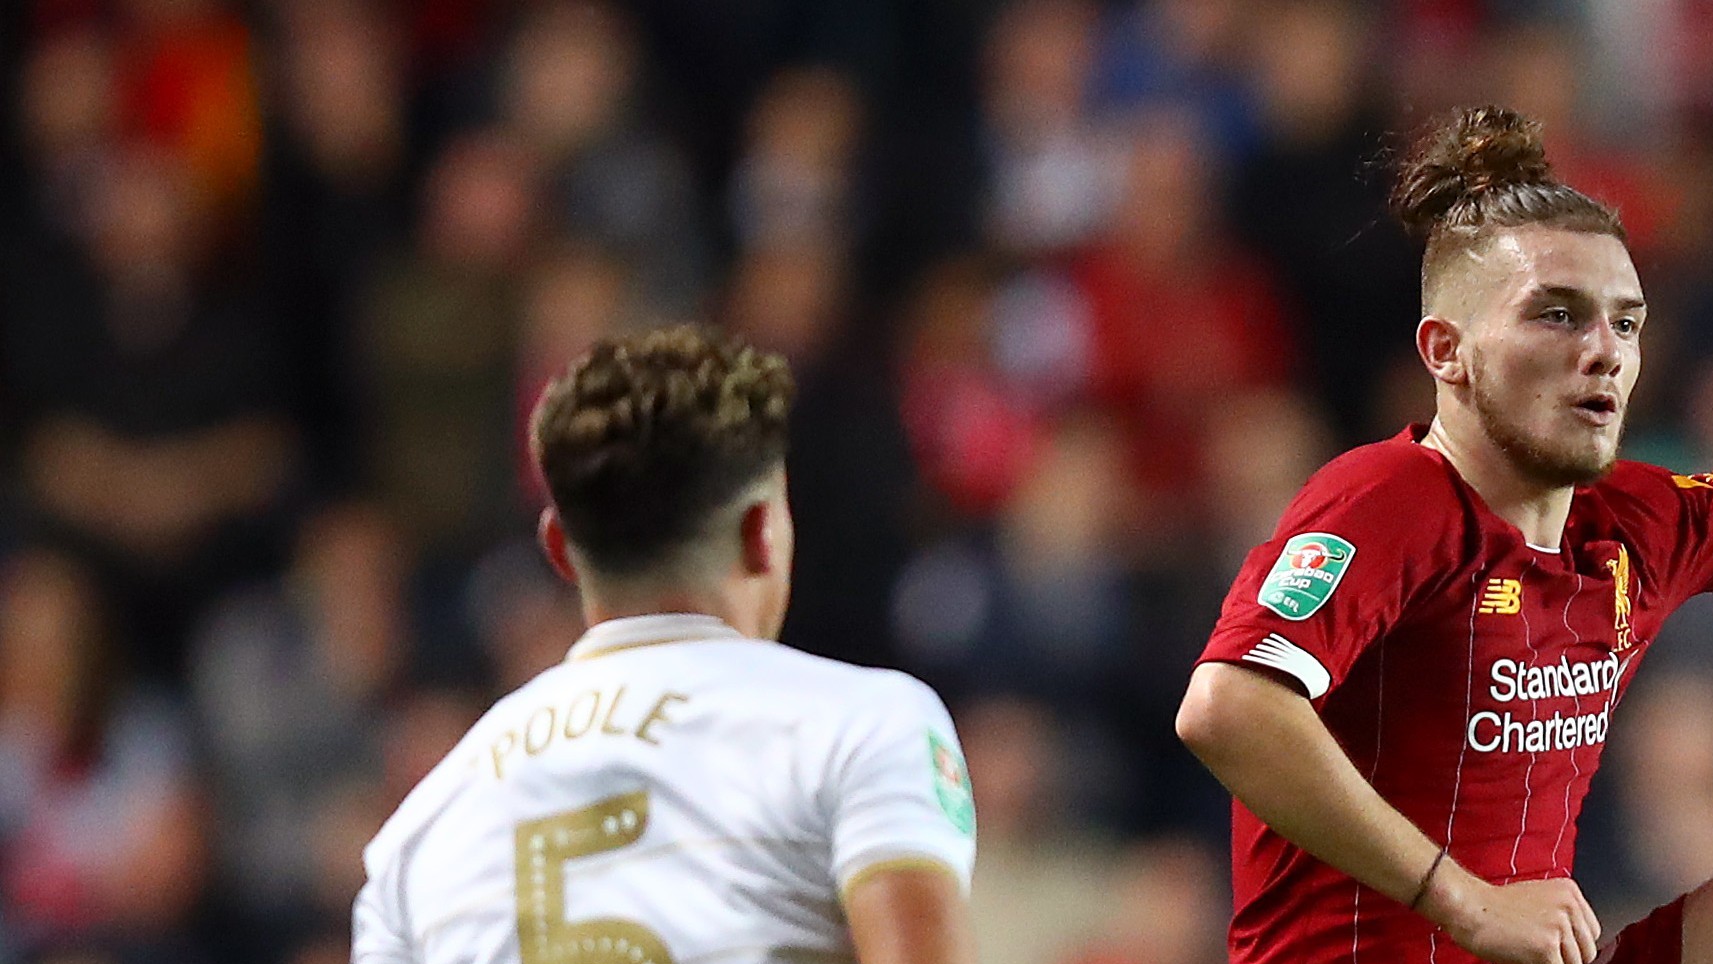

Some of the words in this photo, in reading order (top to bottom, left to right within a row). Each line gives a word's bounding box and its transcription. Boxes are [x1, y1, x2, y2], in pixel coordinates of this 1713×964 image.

[1490, 652, 1625, 702] Standard
[490, 684, 690, 780] POOLE
[1468, 700, 1610, 753] Chartered
